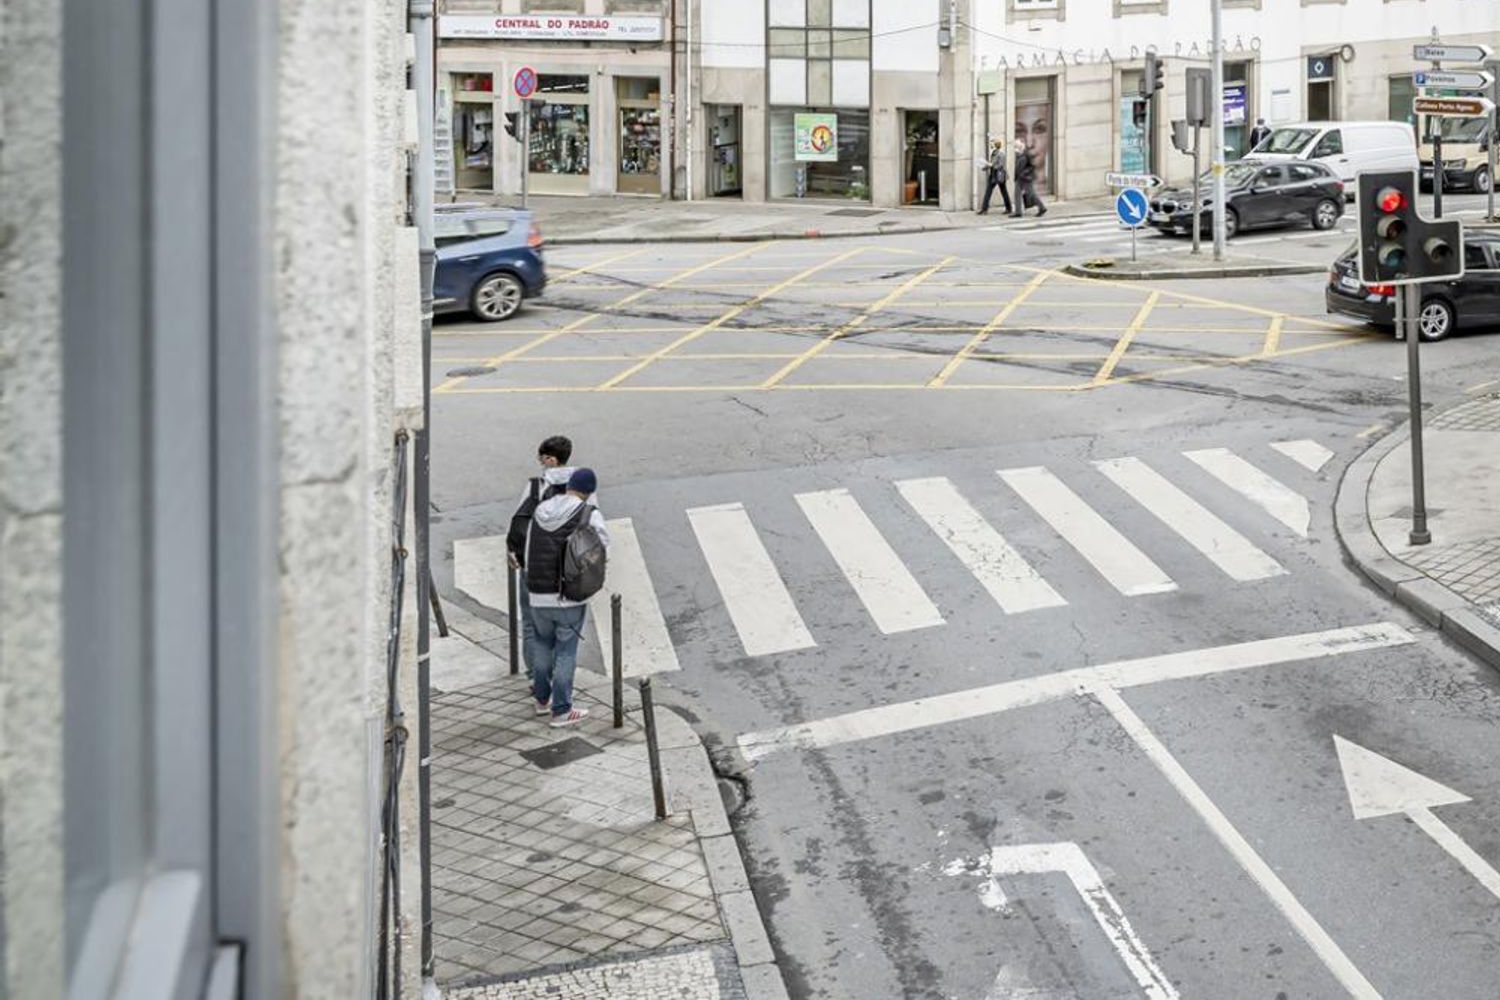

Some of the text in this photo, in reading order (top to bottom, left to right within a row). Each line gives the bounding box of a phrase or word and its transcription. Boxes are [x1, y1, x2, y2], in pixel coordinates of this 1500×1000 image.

[495, 18, 609, 29] CENTRAL DO PADRÃO
